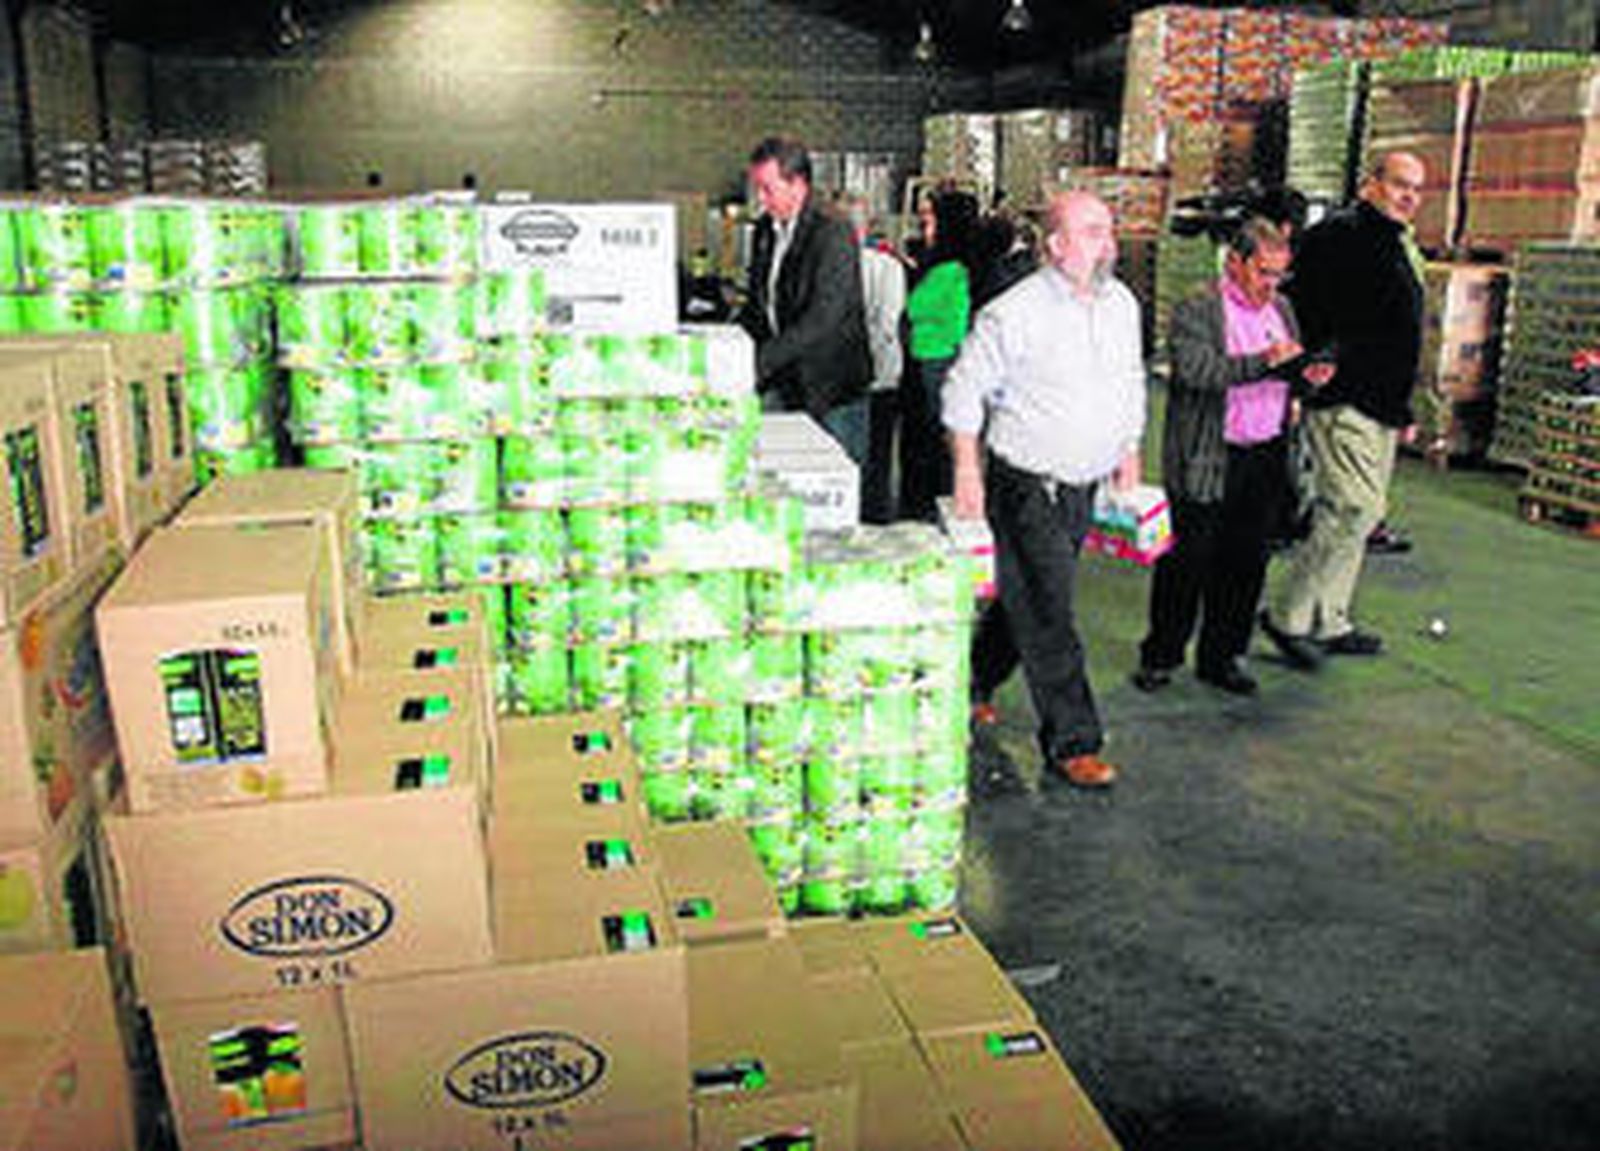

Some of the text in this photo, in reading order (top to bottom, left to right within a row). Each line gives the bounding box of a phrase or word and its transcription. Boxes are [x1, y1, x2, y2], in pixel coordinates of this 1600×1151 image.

[275, 888, 341, 916] DON
[248, 907, 371, 946] SIMON
[496, 1046, 555, 1073] DON
[471, 1059, 583, 1101] SIMON
